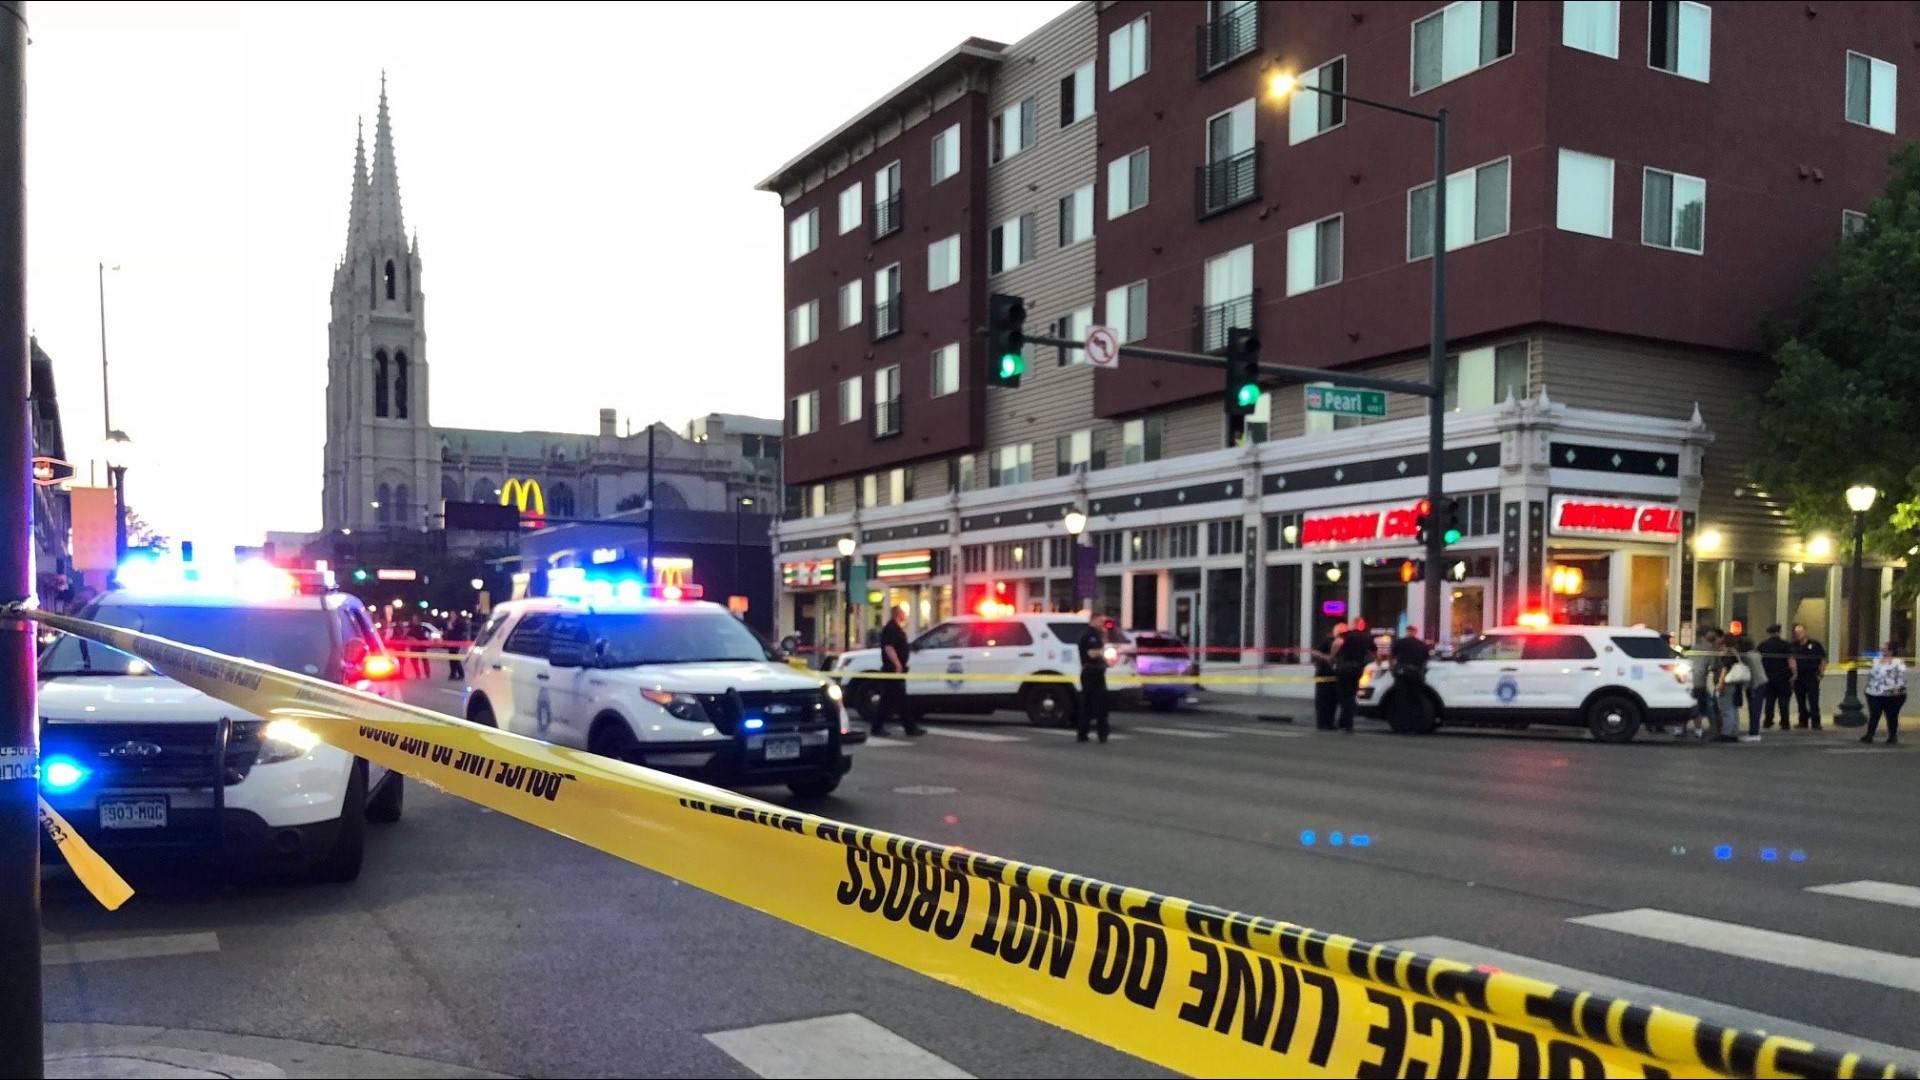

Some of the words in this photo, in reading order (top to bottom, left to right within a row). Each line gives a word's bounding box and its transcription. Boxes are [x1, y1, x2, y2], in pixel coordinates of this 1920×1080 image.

[1325, 392, 1362, 411] Pearl
[837, 845, 968, 940] CROSS
[971, 878, 1078, 978] NOT
[1089, 912, 1167, 1009] DO
[1179, 938, 1339, 1067] LINE
